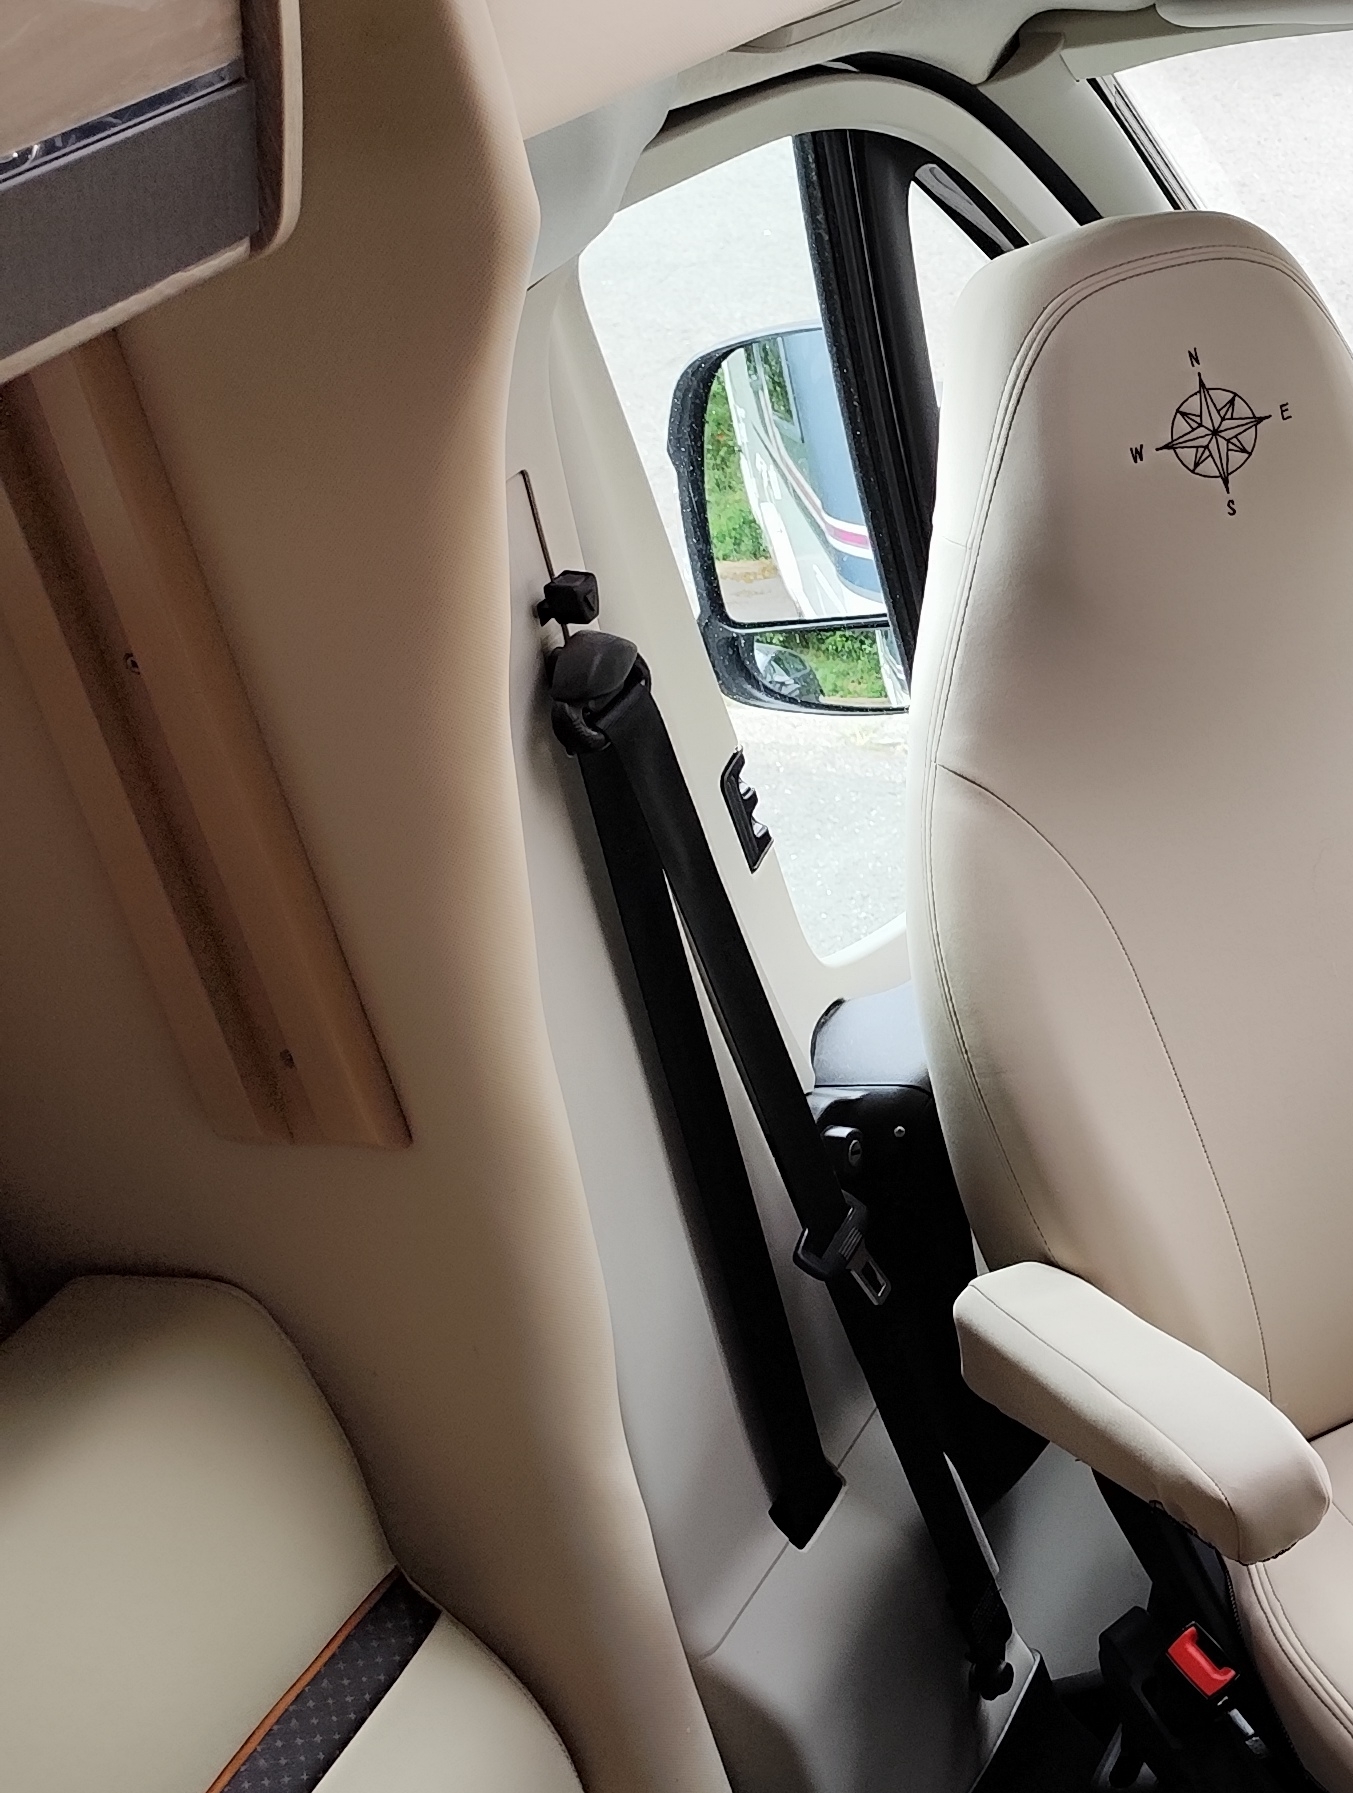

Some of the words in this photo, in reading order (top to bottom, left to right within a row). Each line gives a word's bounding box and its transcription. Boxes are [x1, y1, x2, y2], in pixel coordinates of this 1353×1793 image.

[1188, 347, 1200, 367] N
[1279, 402, 1292, 420] E
[1130, 444, 1144, 463] W
[1227, 499, 1237, 516] S
